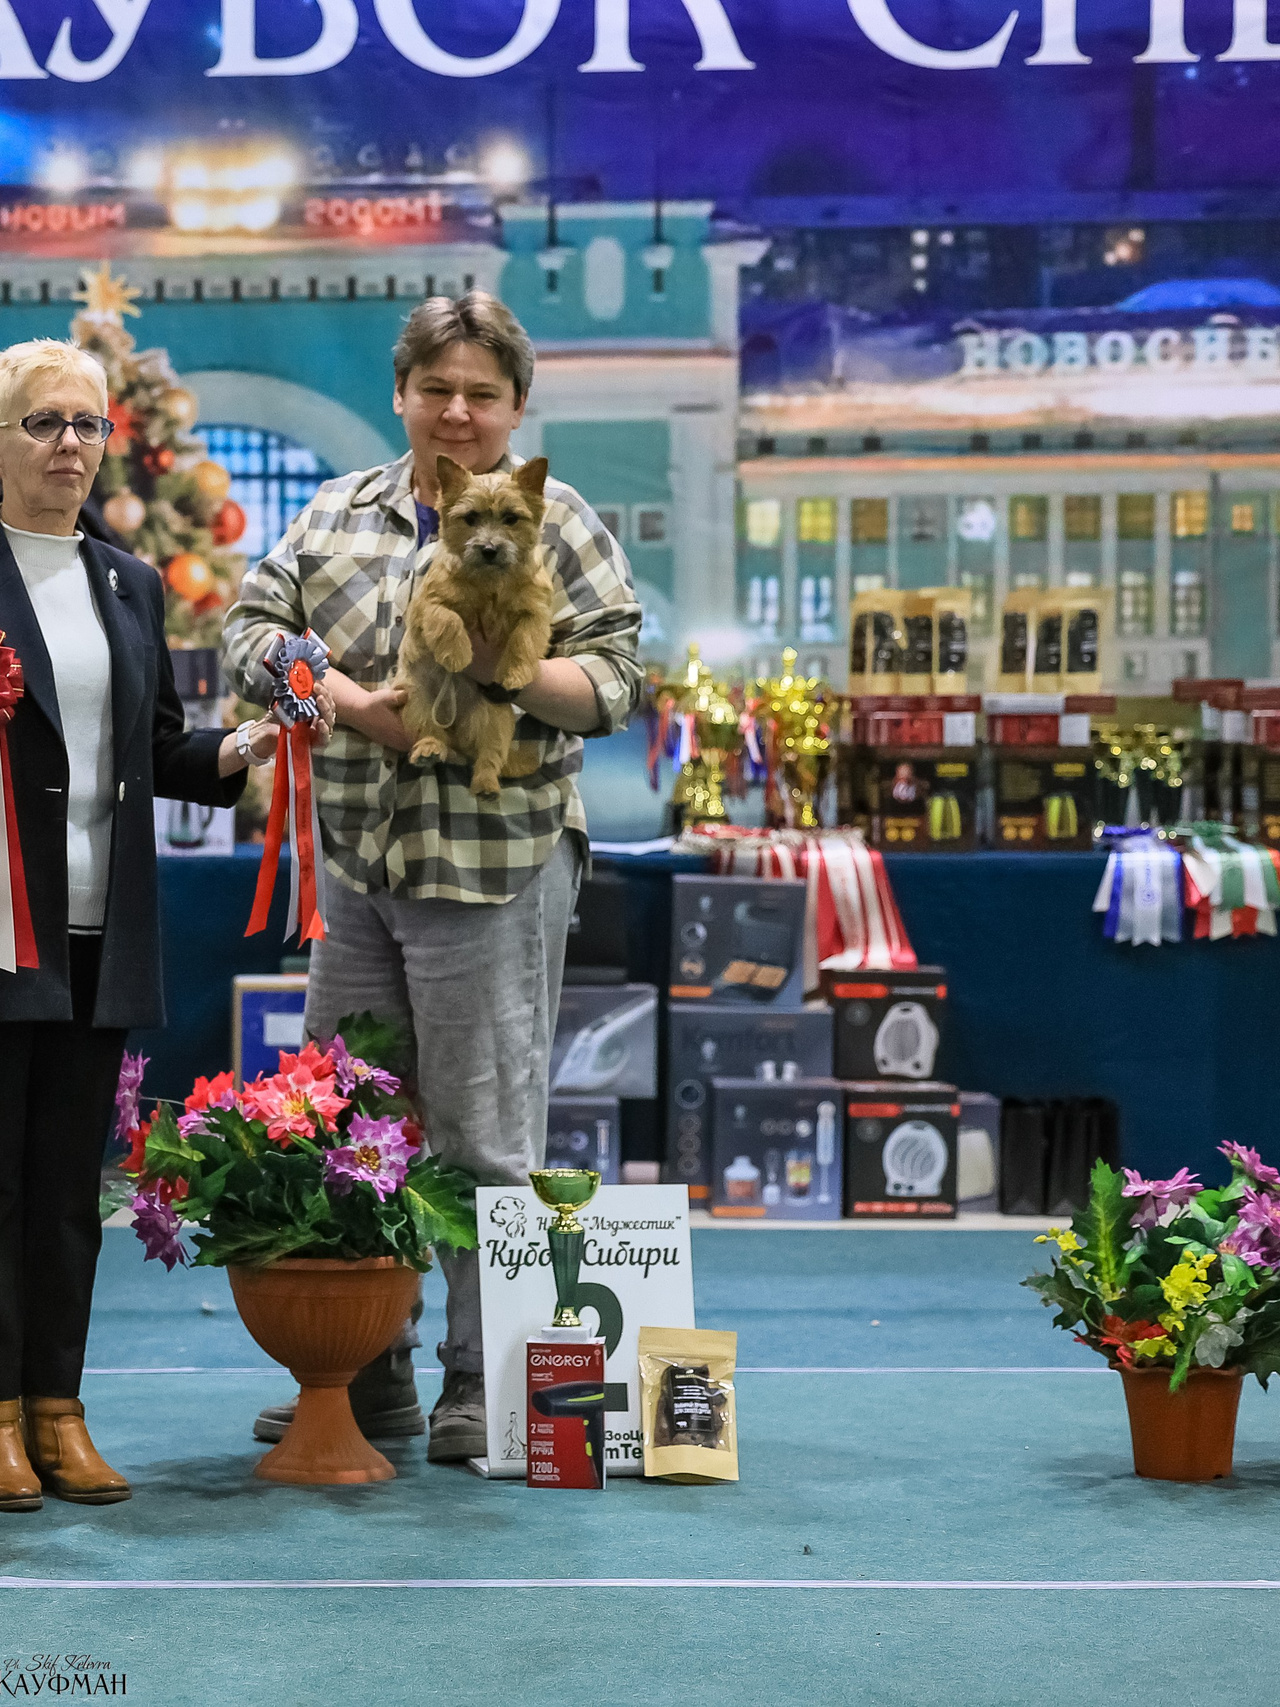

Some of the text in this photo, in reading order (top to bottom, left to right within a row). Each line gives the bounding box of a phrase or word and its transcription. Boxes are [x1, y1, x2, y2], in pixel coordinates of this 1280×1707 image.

[486, 1239, 681, 1280] Кубо Сибири
[530, 1423, 537, 1434] 2
[605, 1430, 643, 1442] ЗооЦ
[531, 1462, 553, 1473] 1200
